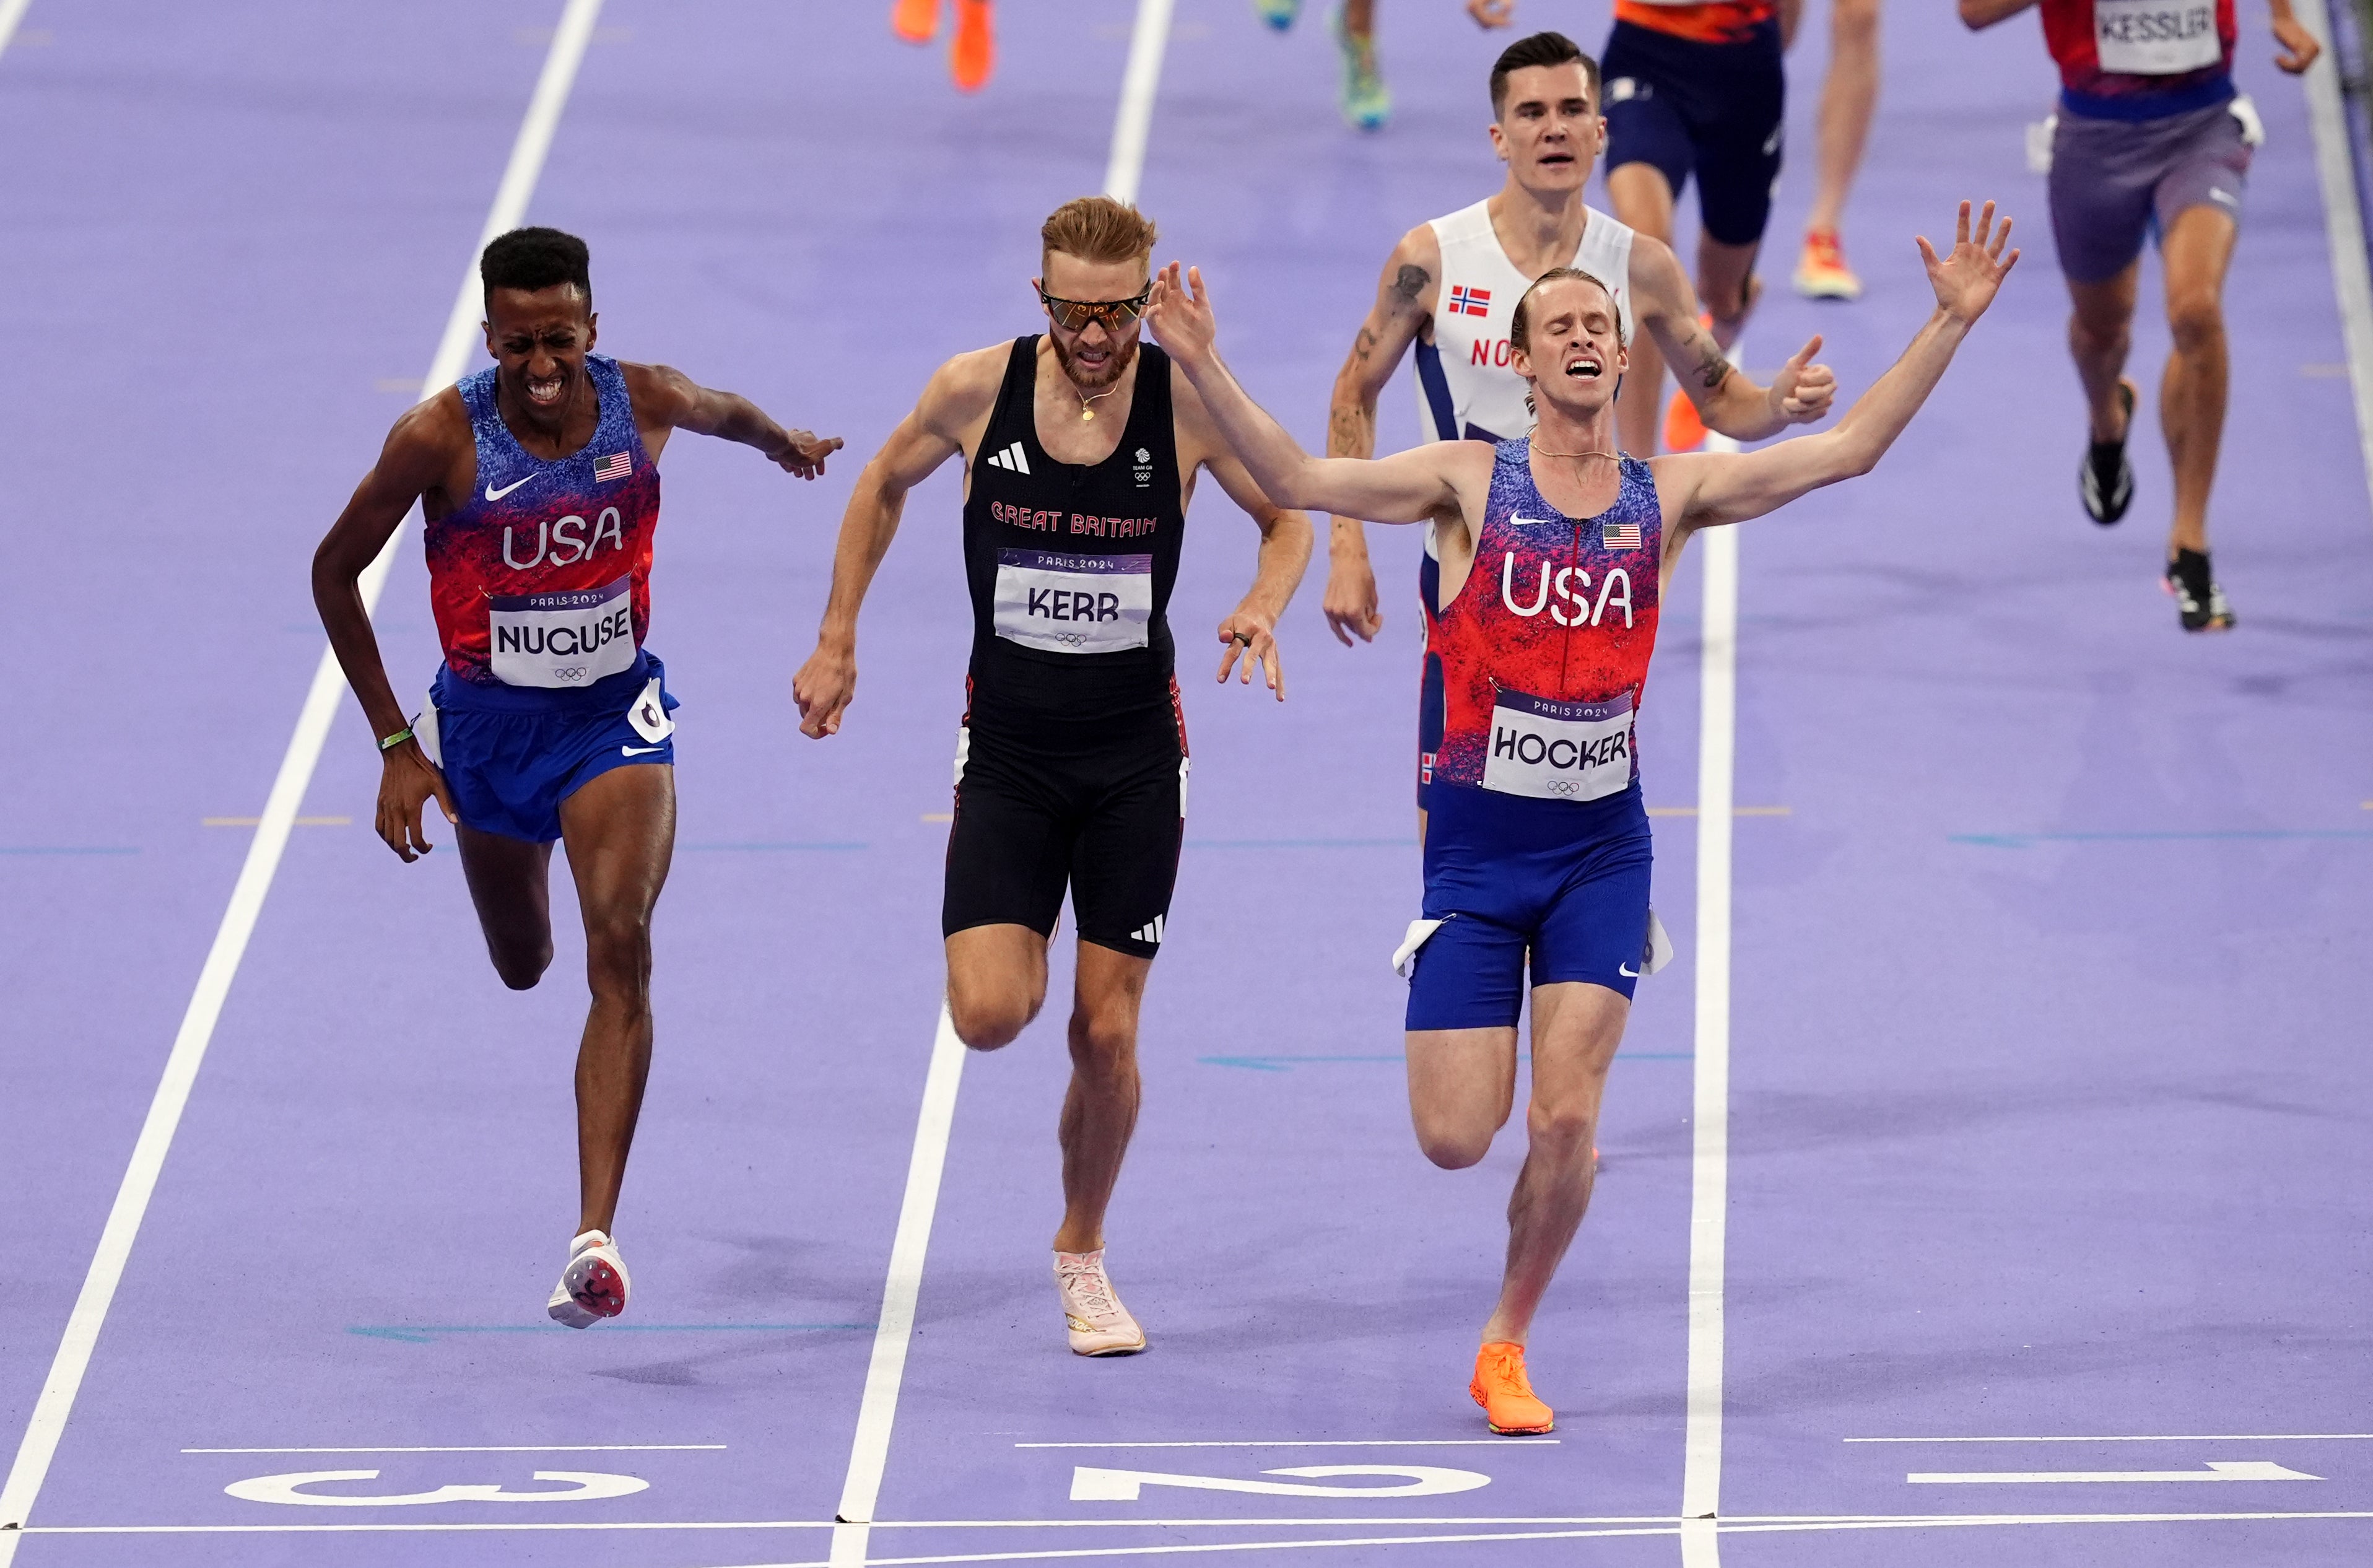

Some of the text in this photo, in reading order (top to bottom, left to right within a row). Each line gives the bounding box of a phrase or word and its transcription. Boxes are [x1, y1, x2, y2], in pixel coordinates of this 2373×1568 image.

[991, 501, 1157, 538] GREAT BRITAIN
[503, 507, 622, 570] USA
[1038, 555, 1114, 569] PARIS 2024
[531, 593, 603, 606] PARIS 2024
[1028, 588, 1119, 622] KERR
[1502, 551, 1633, 629] USA
[498, 607, 628, 655] NUGUSE
[1535, 700, 1608, 718] PARIS 2024
[1494, 726, 1627, 770] HOCKER
[224, 1470, 650, 1506] 3
[1069, 1465, 1491, 1501] 2
[1907, 1461, 2328, 1483] 1
